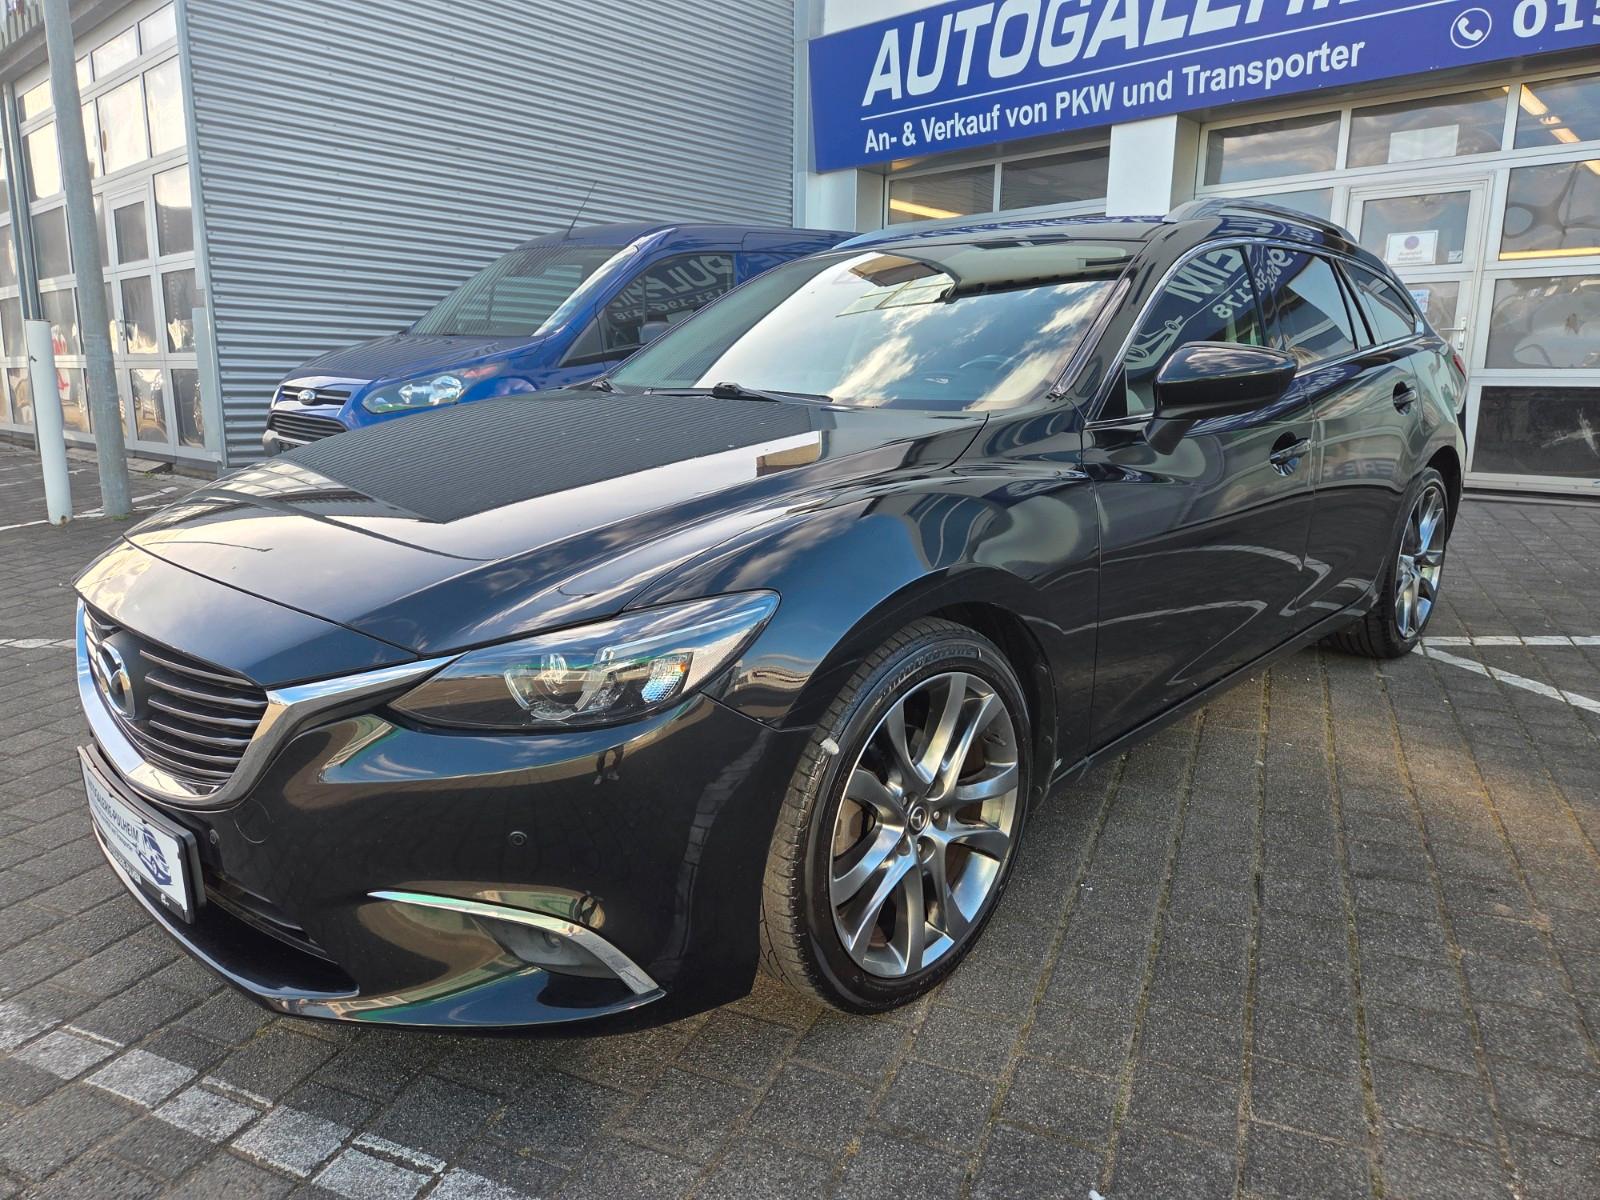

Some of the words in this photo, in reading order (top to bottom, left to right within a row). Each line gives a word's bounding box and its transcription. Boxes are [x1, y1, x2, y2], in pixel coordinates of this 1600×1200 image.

[862, 0, 1361, 107] AUTOGAL
[1512, 0, 1600, 38] 01
[864, 128, 898, 154] An-
[902, 121, 917, 146] &
[920, 104, 1001, 143] Verkauf
[1005, 101, 1047, 128] von
[1055, 81, 1116, 120] PKW
[1122, 70, 1174, 107] und
[1181, 41, 1366, 96] Transporter
